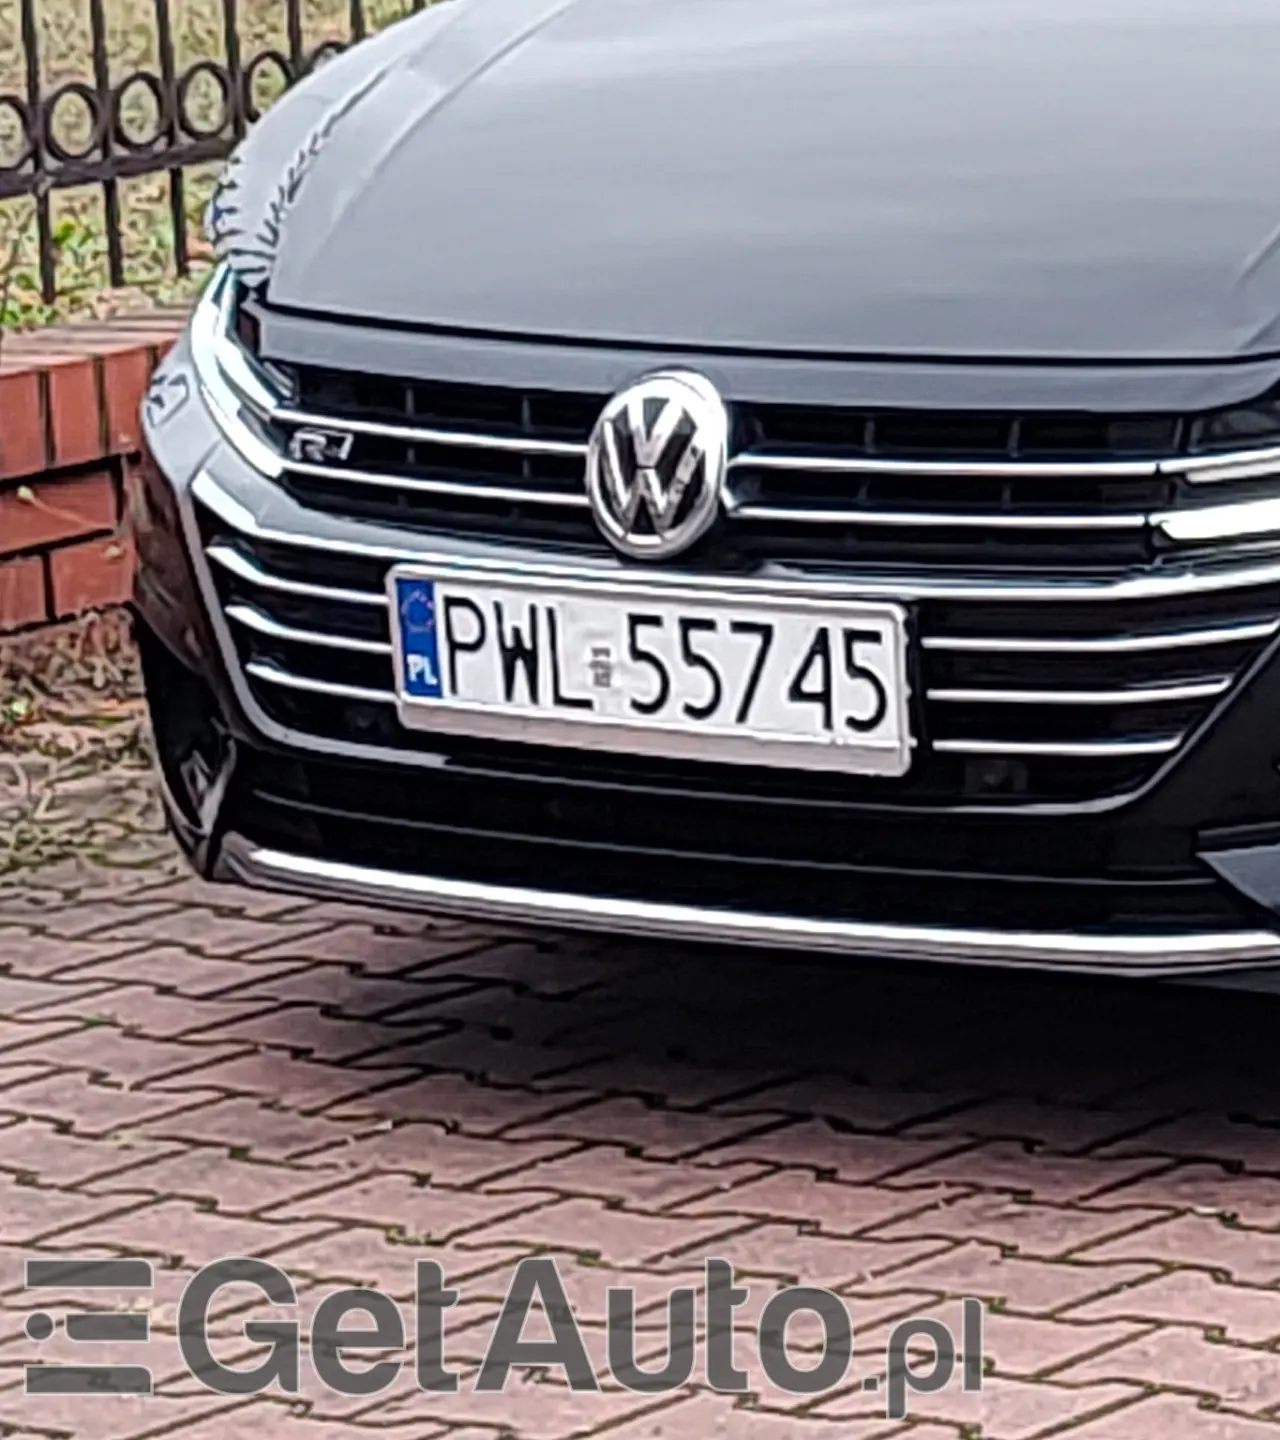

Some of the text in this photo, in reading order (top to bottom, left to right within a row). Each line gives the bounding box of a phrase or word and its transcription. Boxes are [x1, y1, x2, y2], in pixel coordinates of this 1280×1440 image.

[406, 653, 438, 686] PL
[443, 594, 888, 732] PWL 55745
